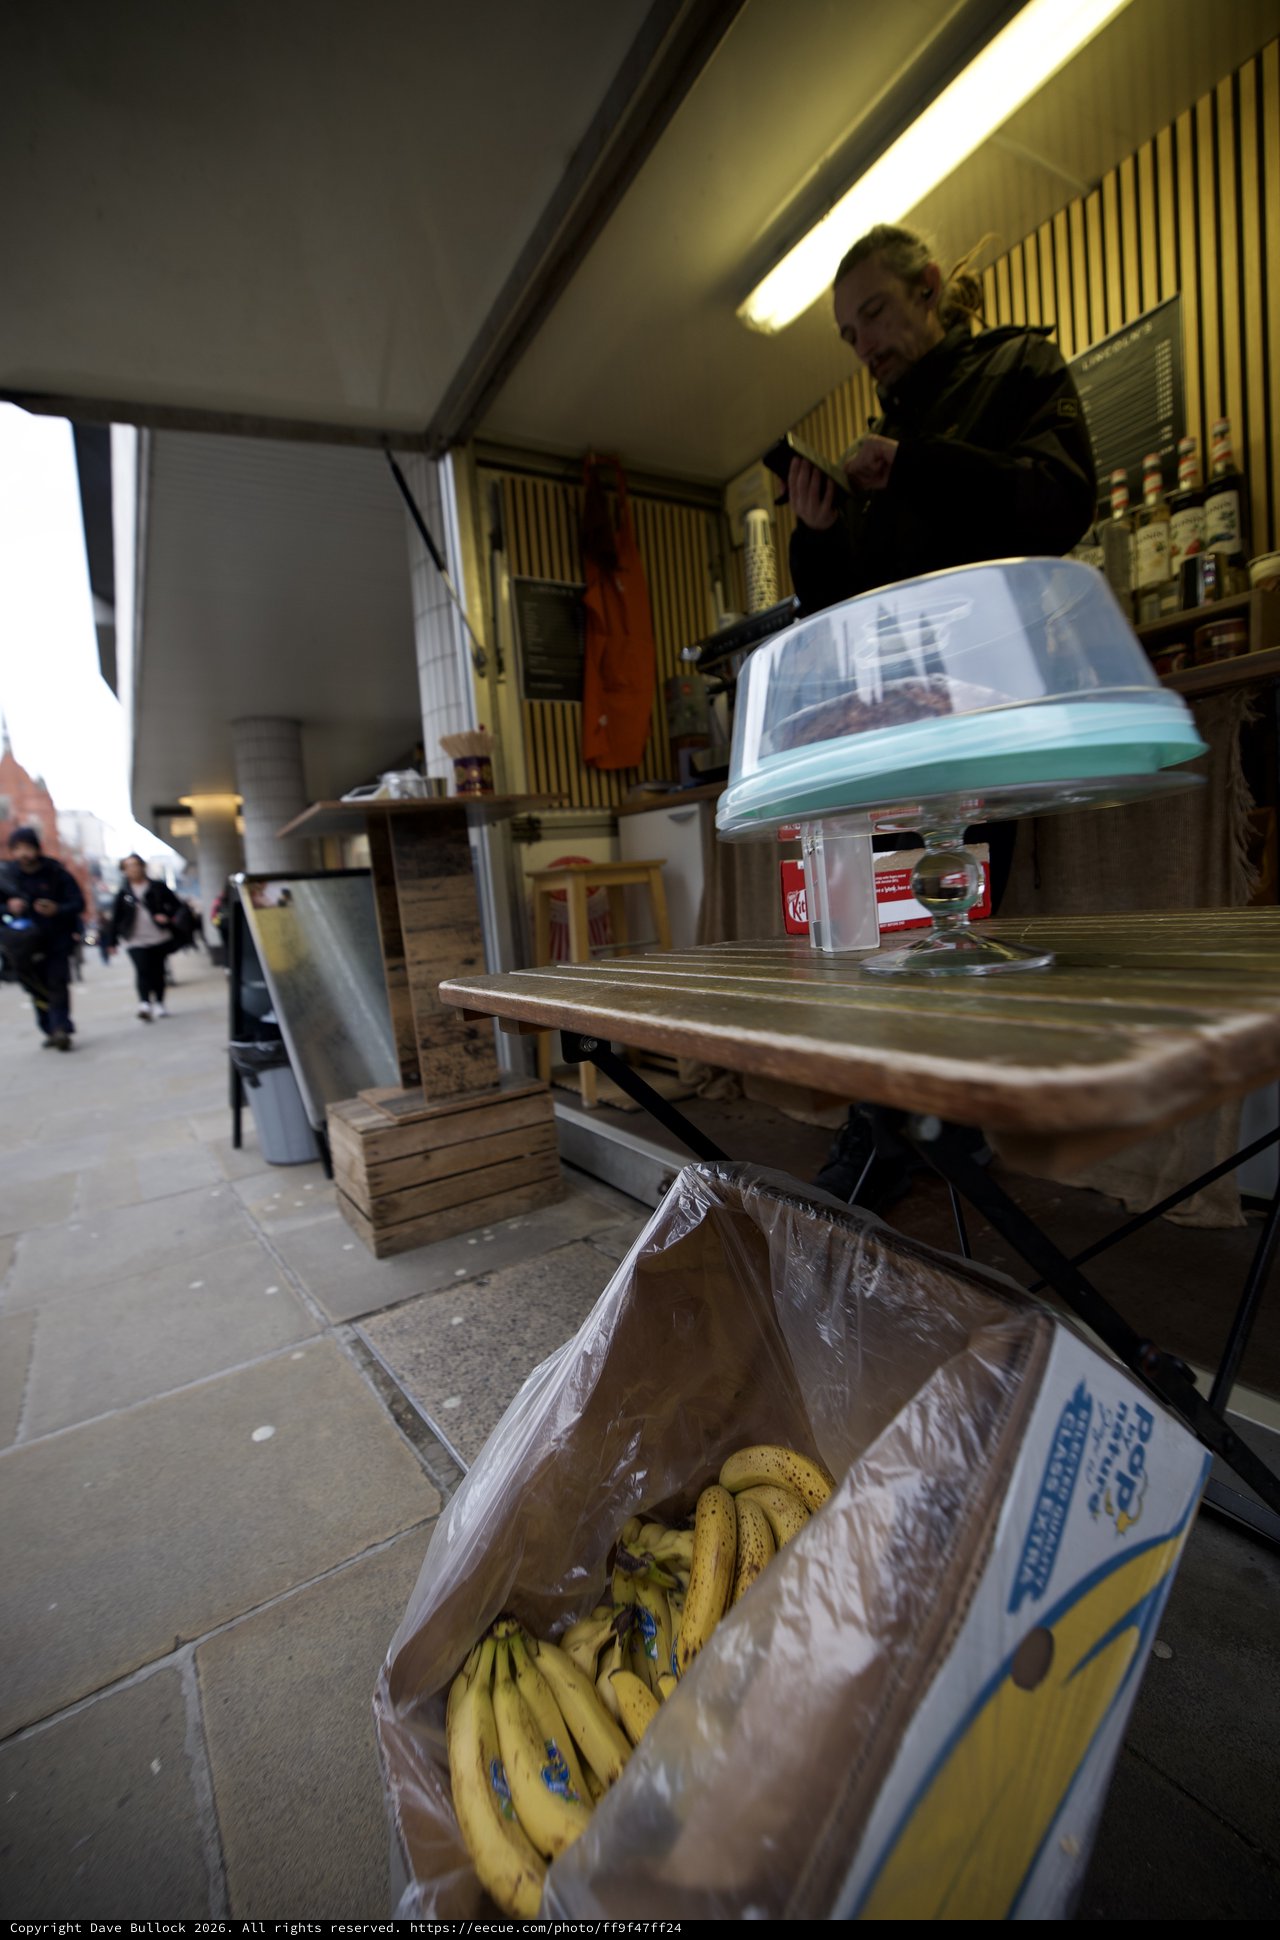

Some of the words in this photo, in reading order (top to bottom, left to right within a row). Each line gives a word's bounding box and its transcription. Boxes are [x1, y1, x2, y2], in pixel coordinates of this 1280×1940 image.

[1044, 1410, 1077, 1494] CLASS
[1058, 1407, 1090, 1502] SELECTED
[1018, 1495, 1055, 1585] EXTRA
[1035, 1503, 1065, 1590] QUALITY
